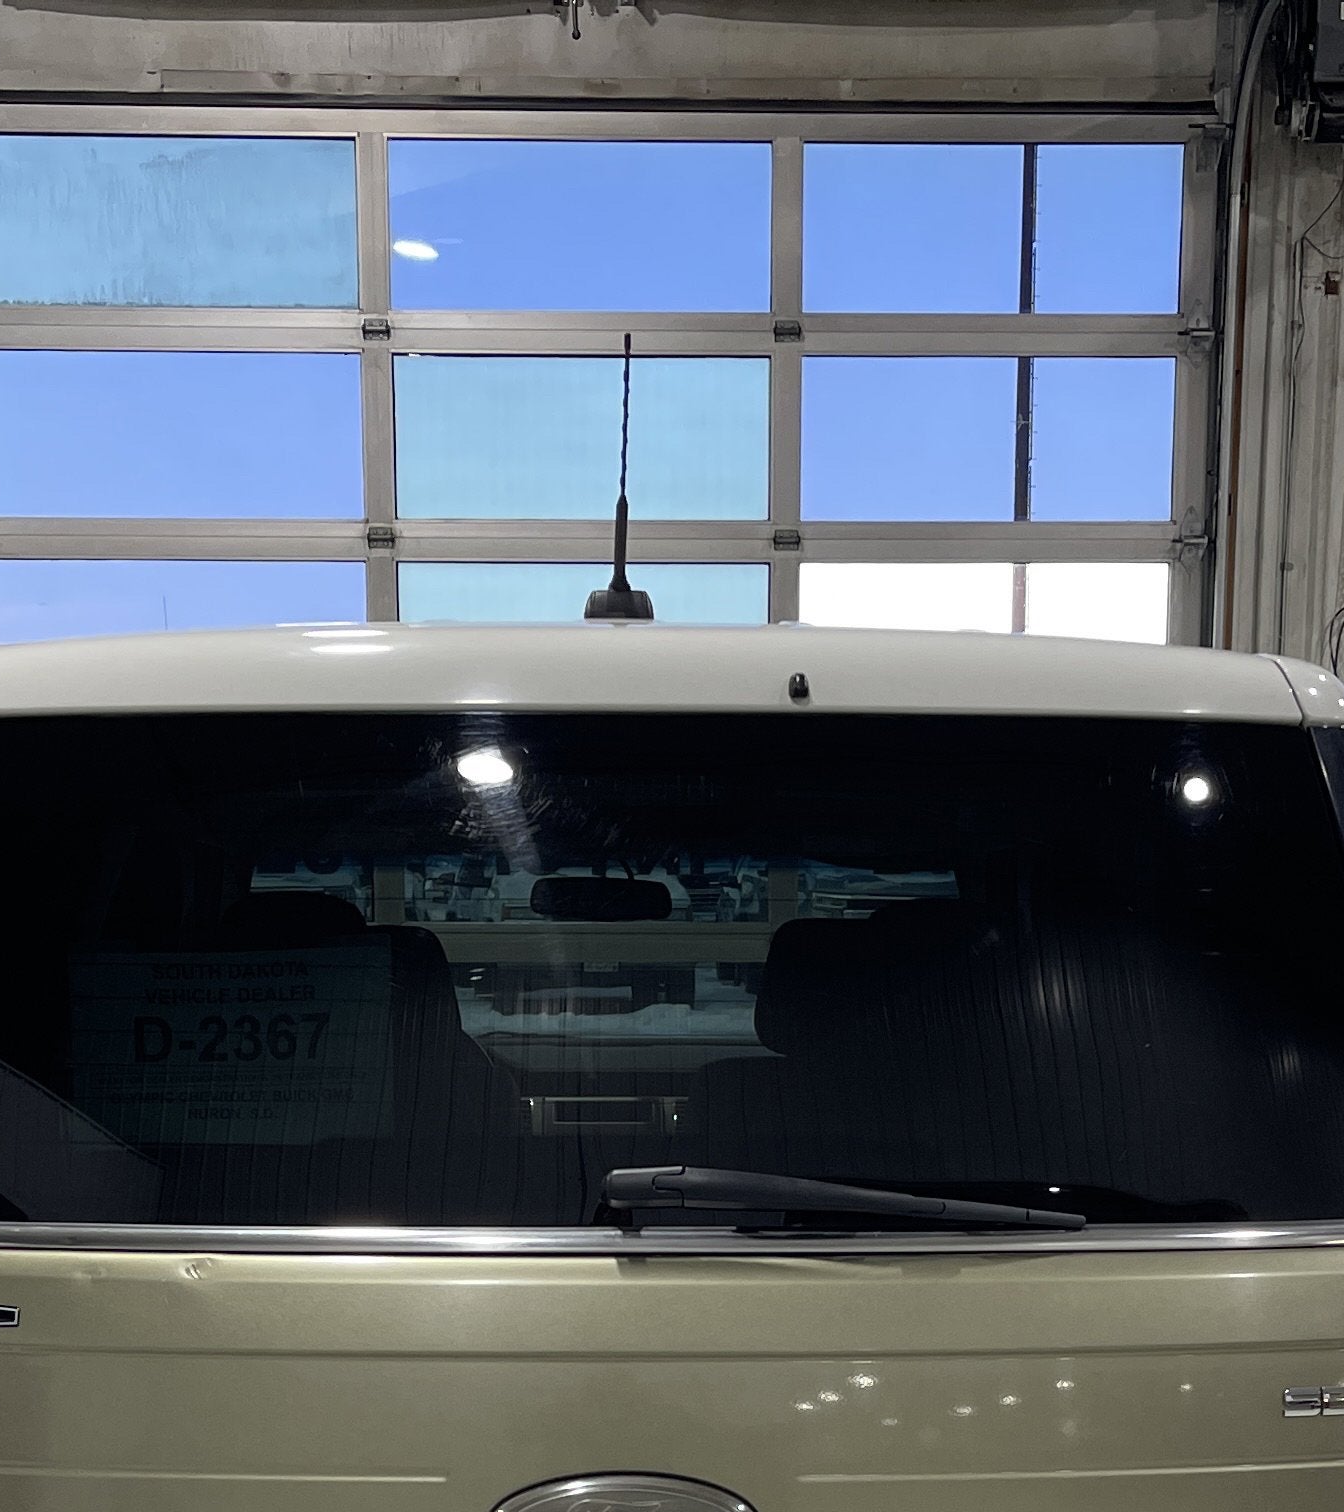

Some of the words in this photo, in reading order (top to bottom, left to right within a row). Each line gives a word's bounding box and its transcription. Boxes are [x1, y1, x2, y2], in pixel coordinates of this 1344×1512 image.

[151, 963, 222, 980] SOUTH
[228, 961, 309, 979] DAKOTA
[145, 987, 230, 1005] VEHICLE
[237, 984, 315, 1003] DEALER
[134, 1012, 330, 1063] D-2367
